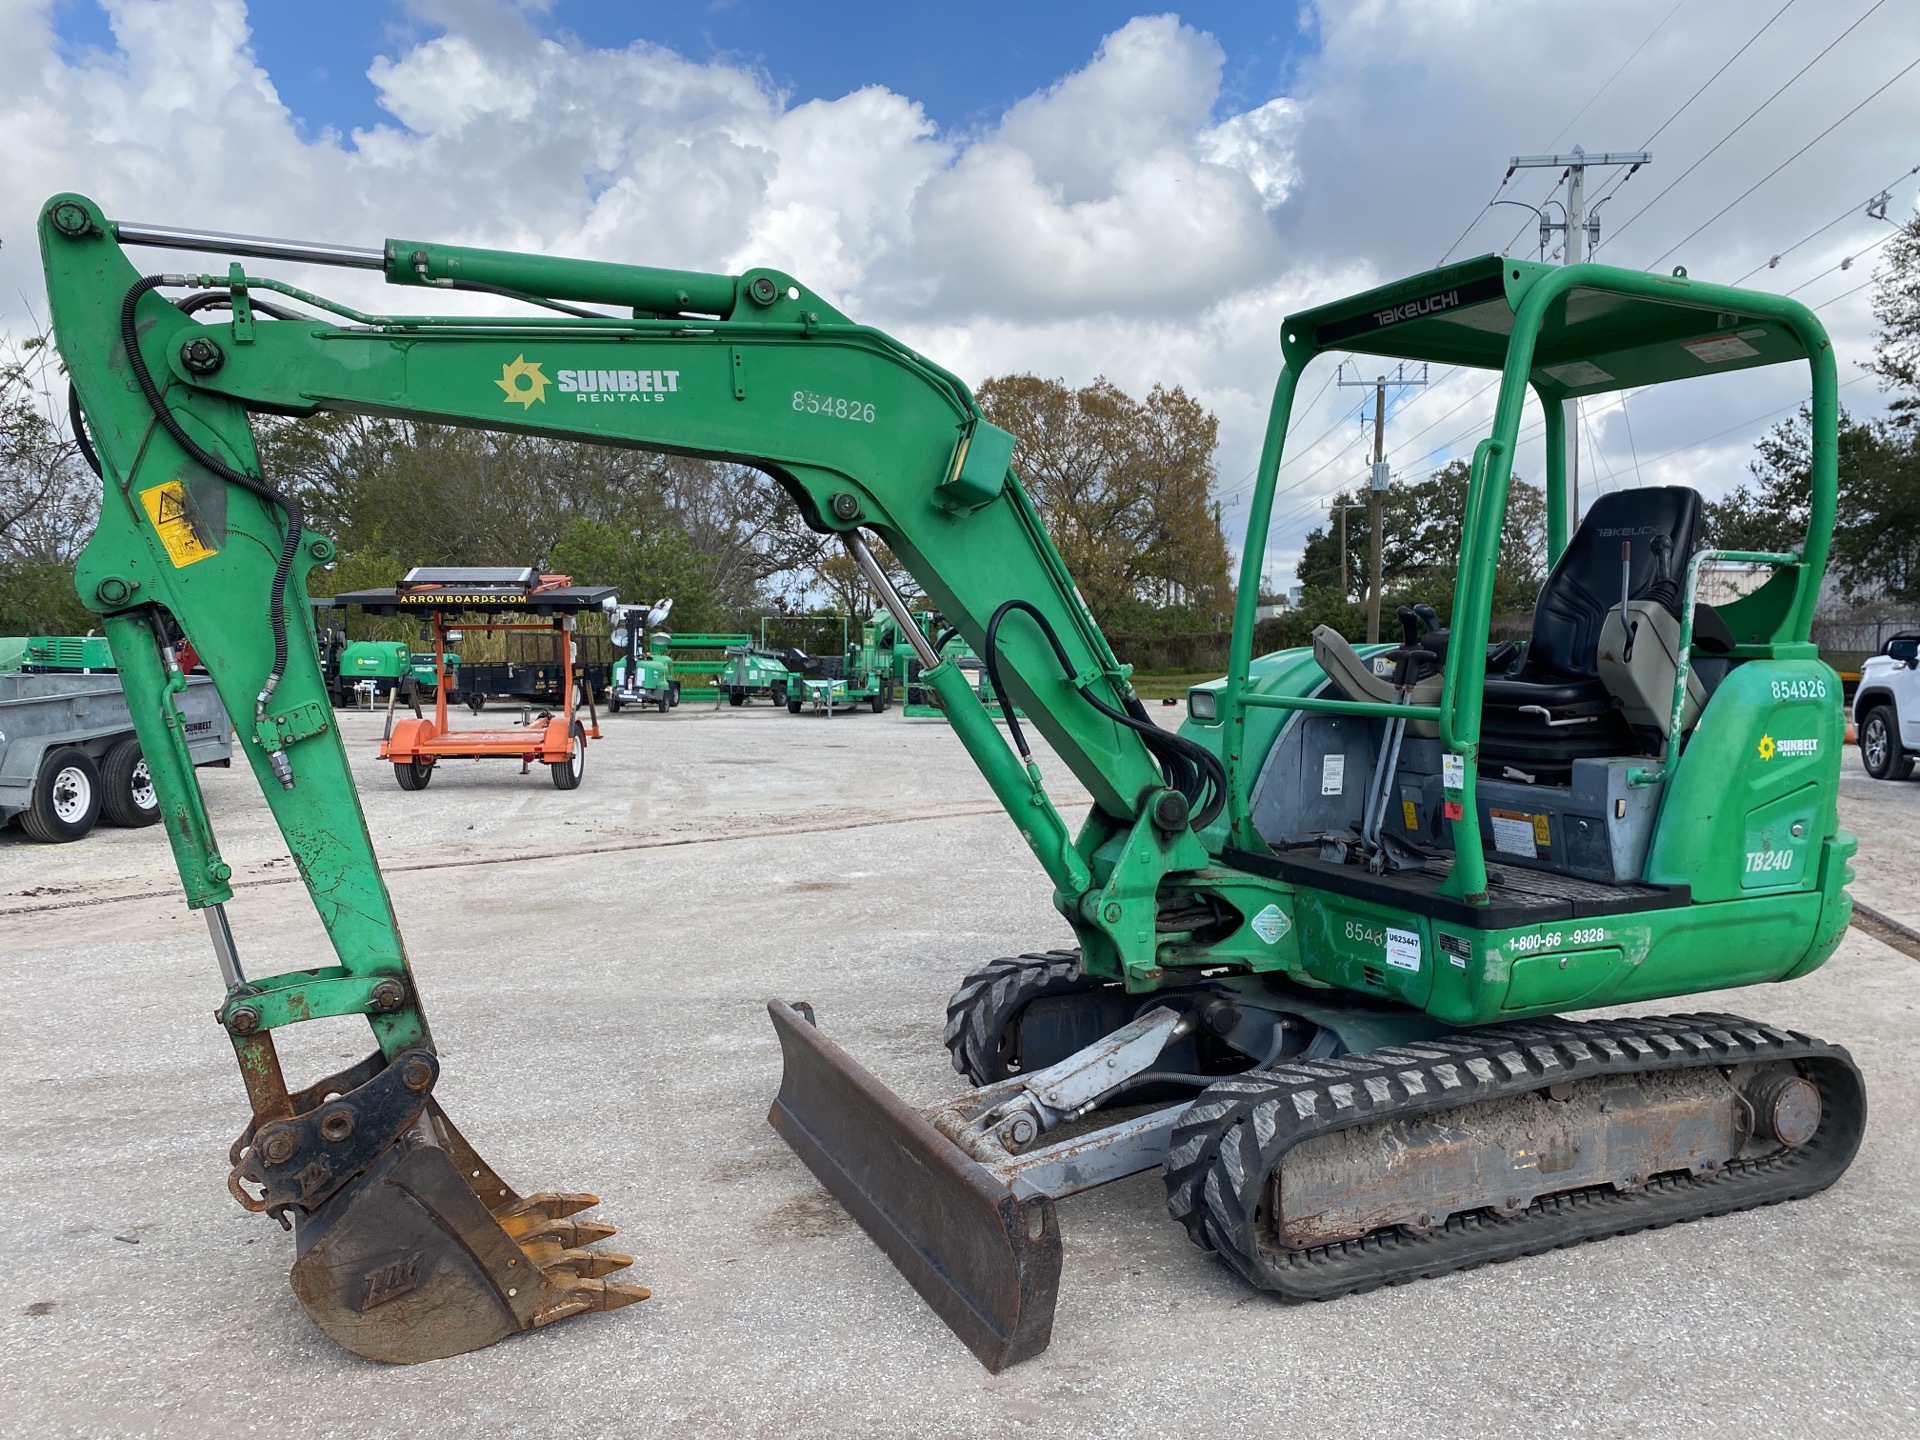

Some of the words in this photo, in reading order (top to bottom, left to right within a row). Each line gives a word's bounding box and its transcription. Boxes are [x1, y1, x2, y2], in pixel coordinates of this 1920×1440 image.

[1373, 290, 1459, 326] TAKEUCHI
[558, 370, 680, 393] SUNBELT
[576, 393, 665, 403] RENTALS
[791, 391, 876, 424] 854826
[1771, 680, 1826, 699] 854826
[185, 720, 212, 732] SUNBELT
[1777, 738, 1819, 752] SUNBELT
[1745, 849, 1794, 873] TB240
[1389, 933, 1419, 947] U623447
